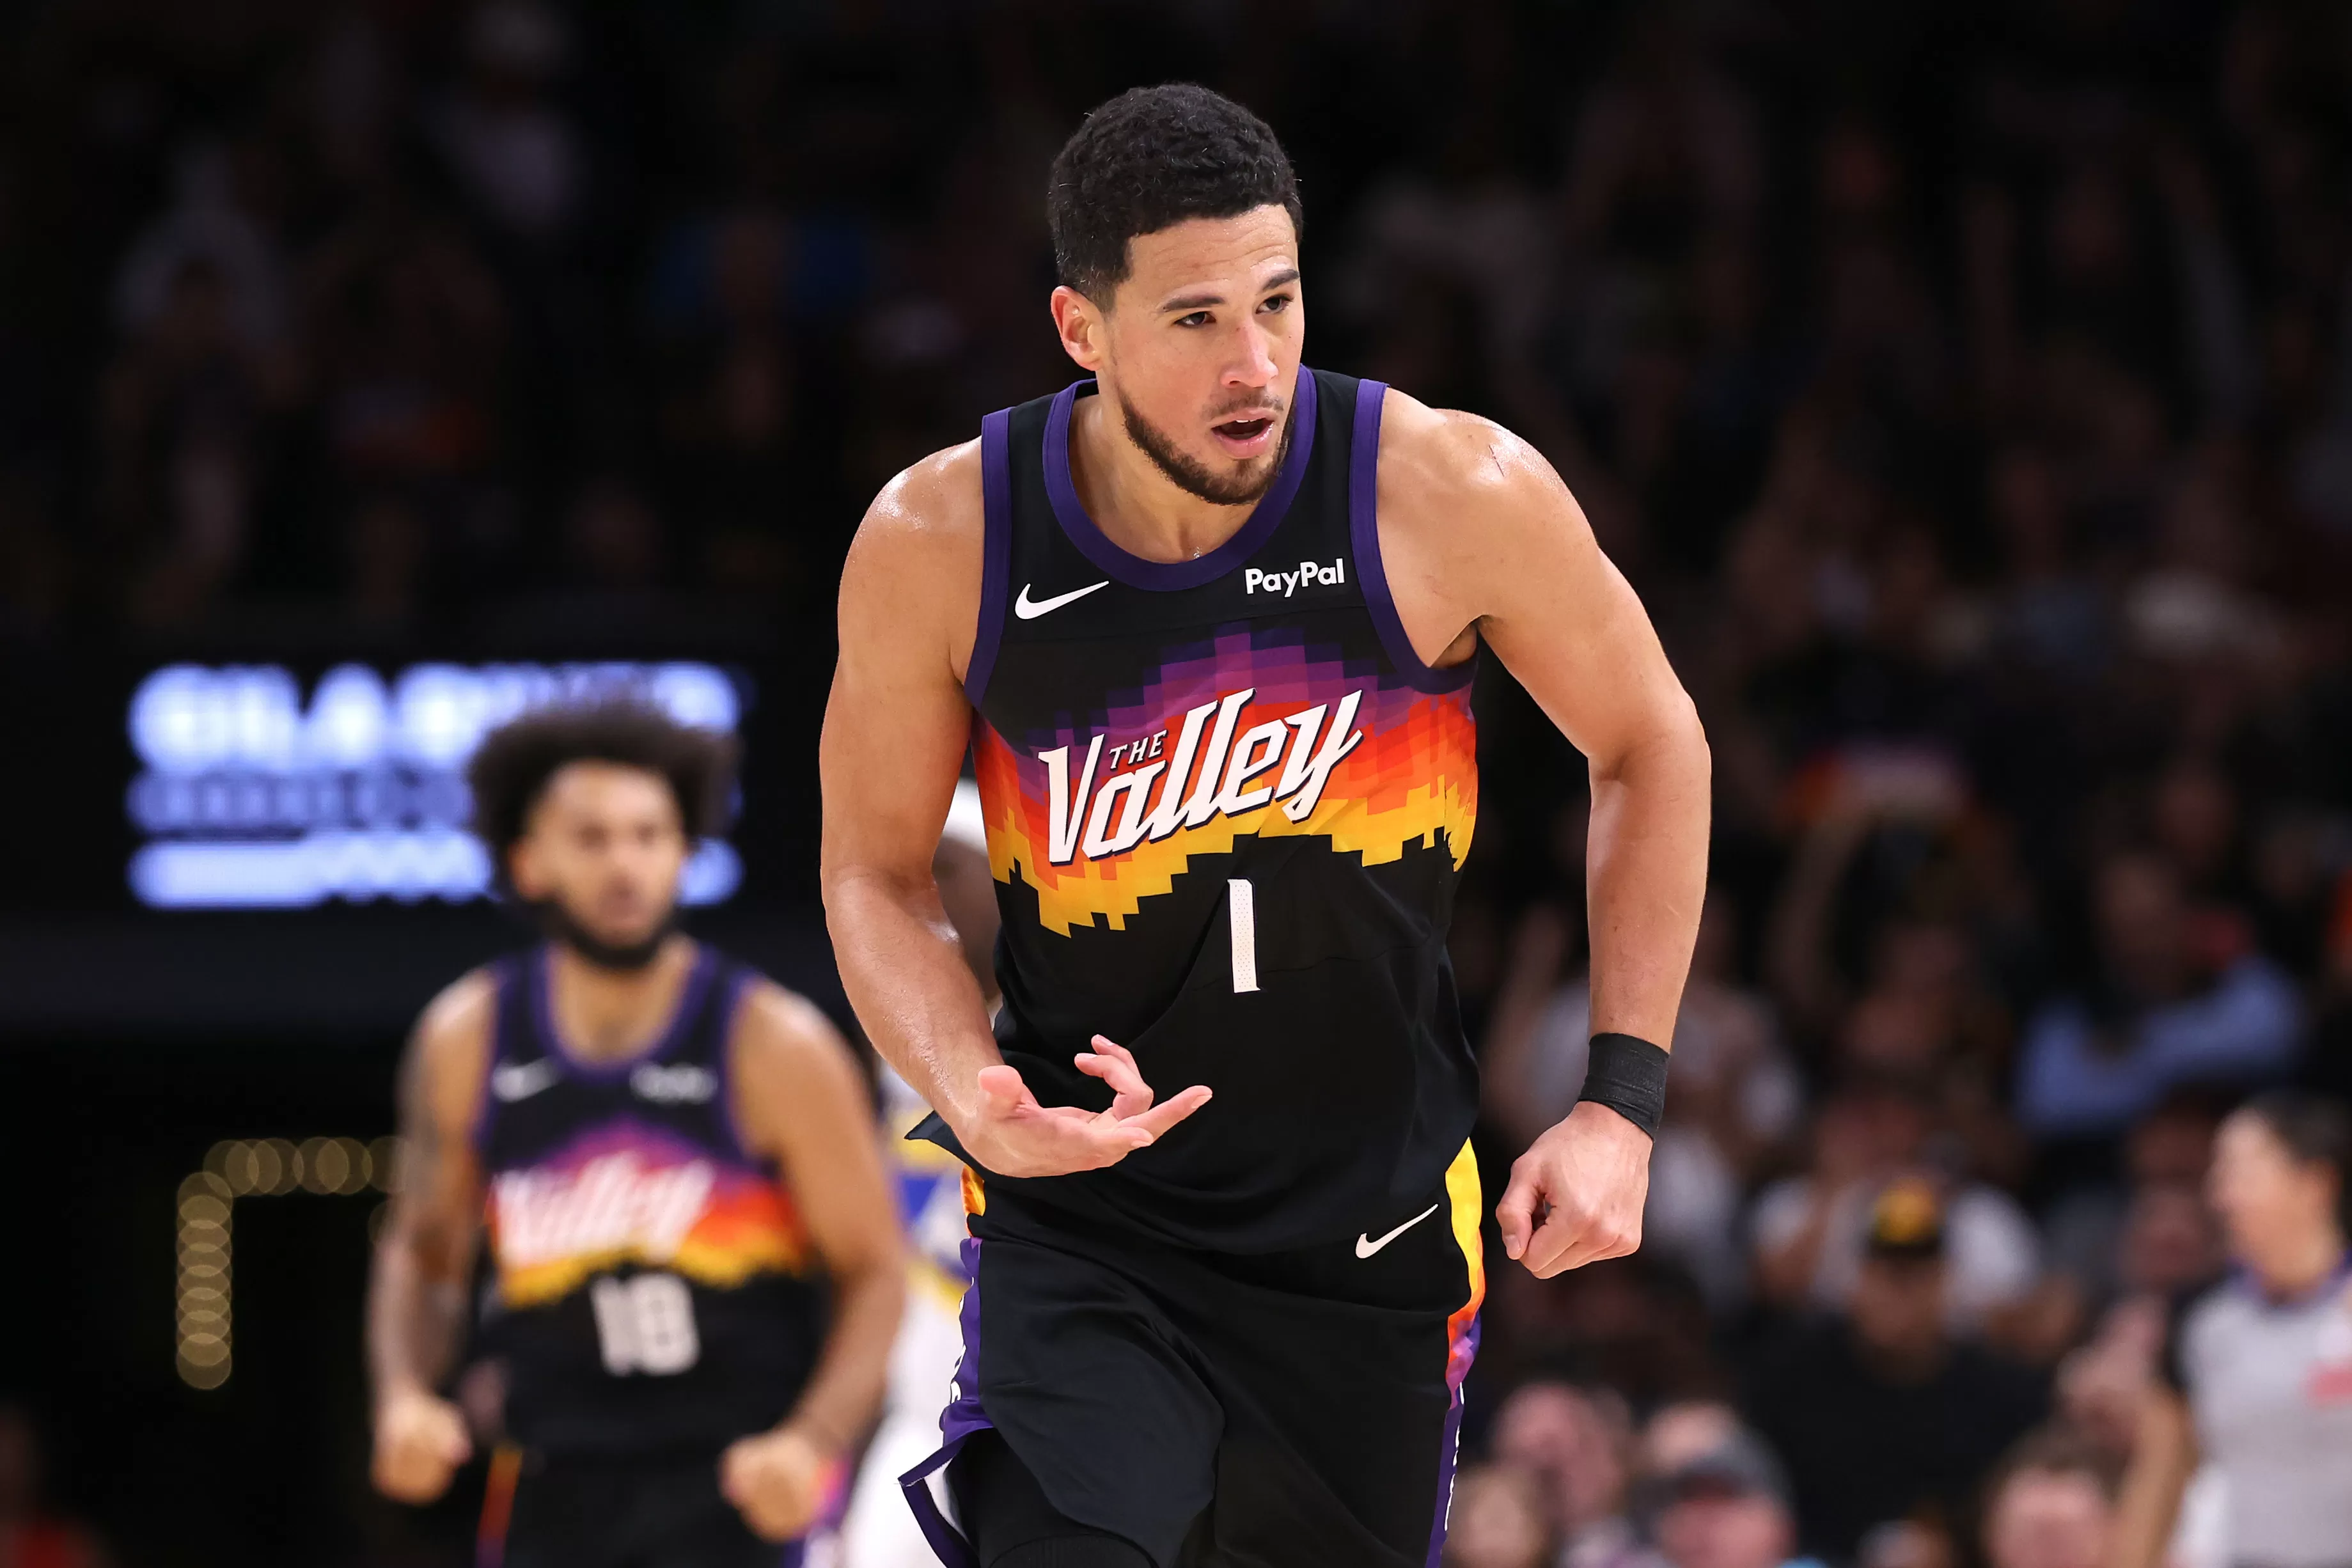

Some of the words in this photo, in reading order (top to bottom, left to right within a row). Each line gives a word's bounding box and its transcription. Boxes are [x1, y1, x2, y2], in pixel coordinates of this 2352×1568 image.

[1245, 558, 1345, 597] PayPal
[1037, 687, 1365, 866] Valley
[1108, 729, 1166, 770] THE
[1227, 877, 1261, 994] 1
[592, 1274, 699, 1375] 18
